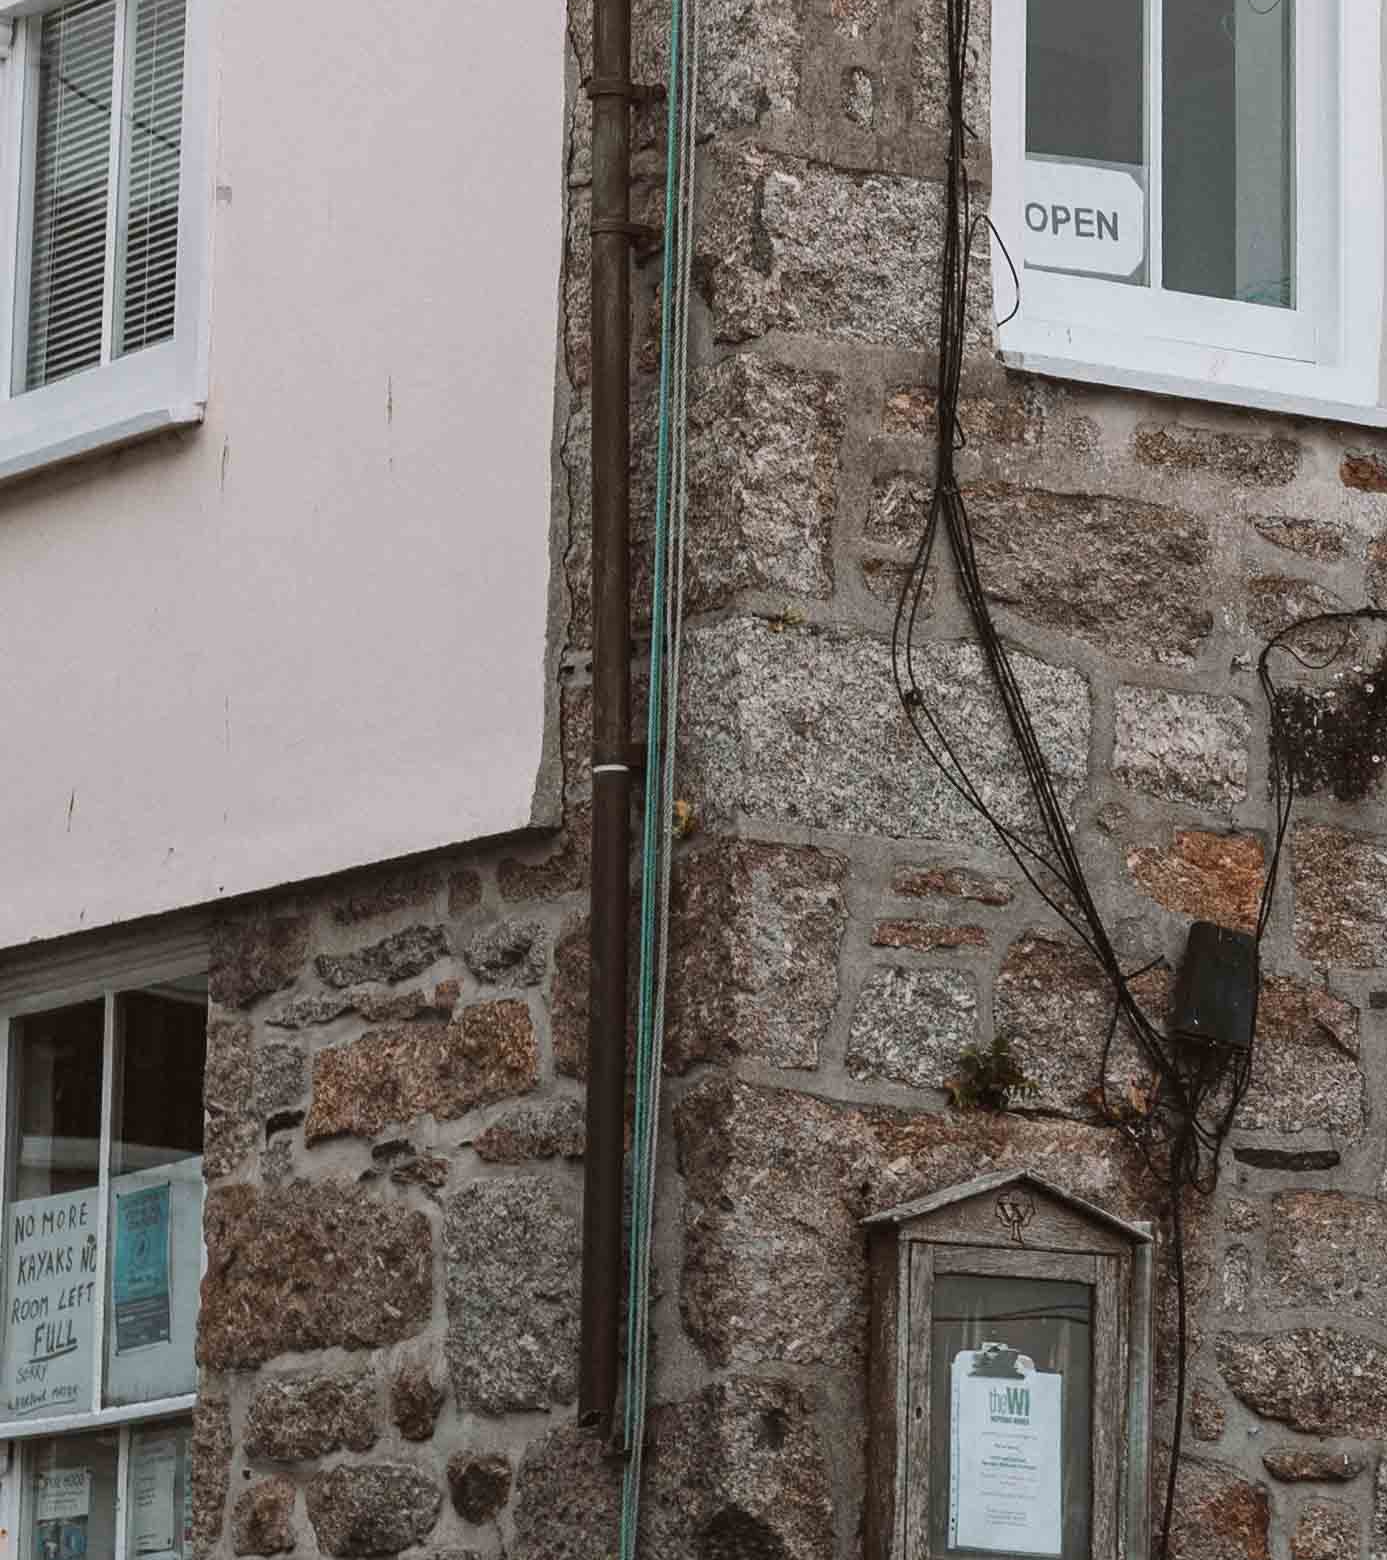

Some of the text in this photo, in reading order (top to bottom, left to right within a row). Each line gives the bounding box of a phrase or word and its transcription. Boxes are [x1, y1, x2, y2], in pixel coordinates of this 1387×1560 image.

[1024, 201, 1119, 242] OPEN
[14, 1202, 89, 1245] NO MORE
[17, 1246, 73, 1287] KAYAKS
[11, 1281, 96, 1324] ROOM LEFT
[32, 1319, 78, 1356] FULL
